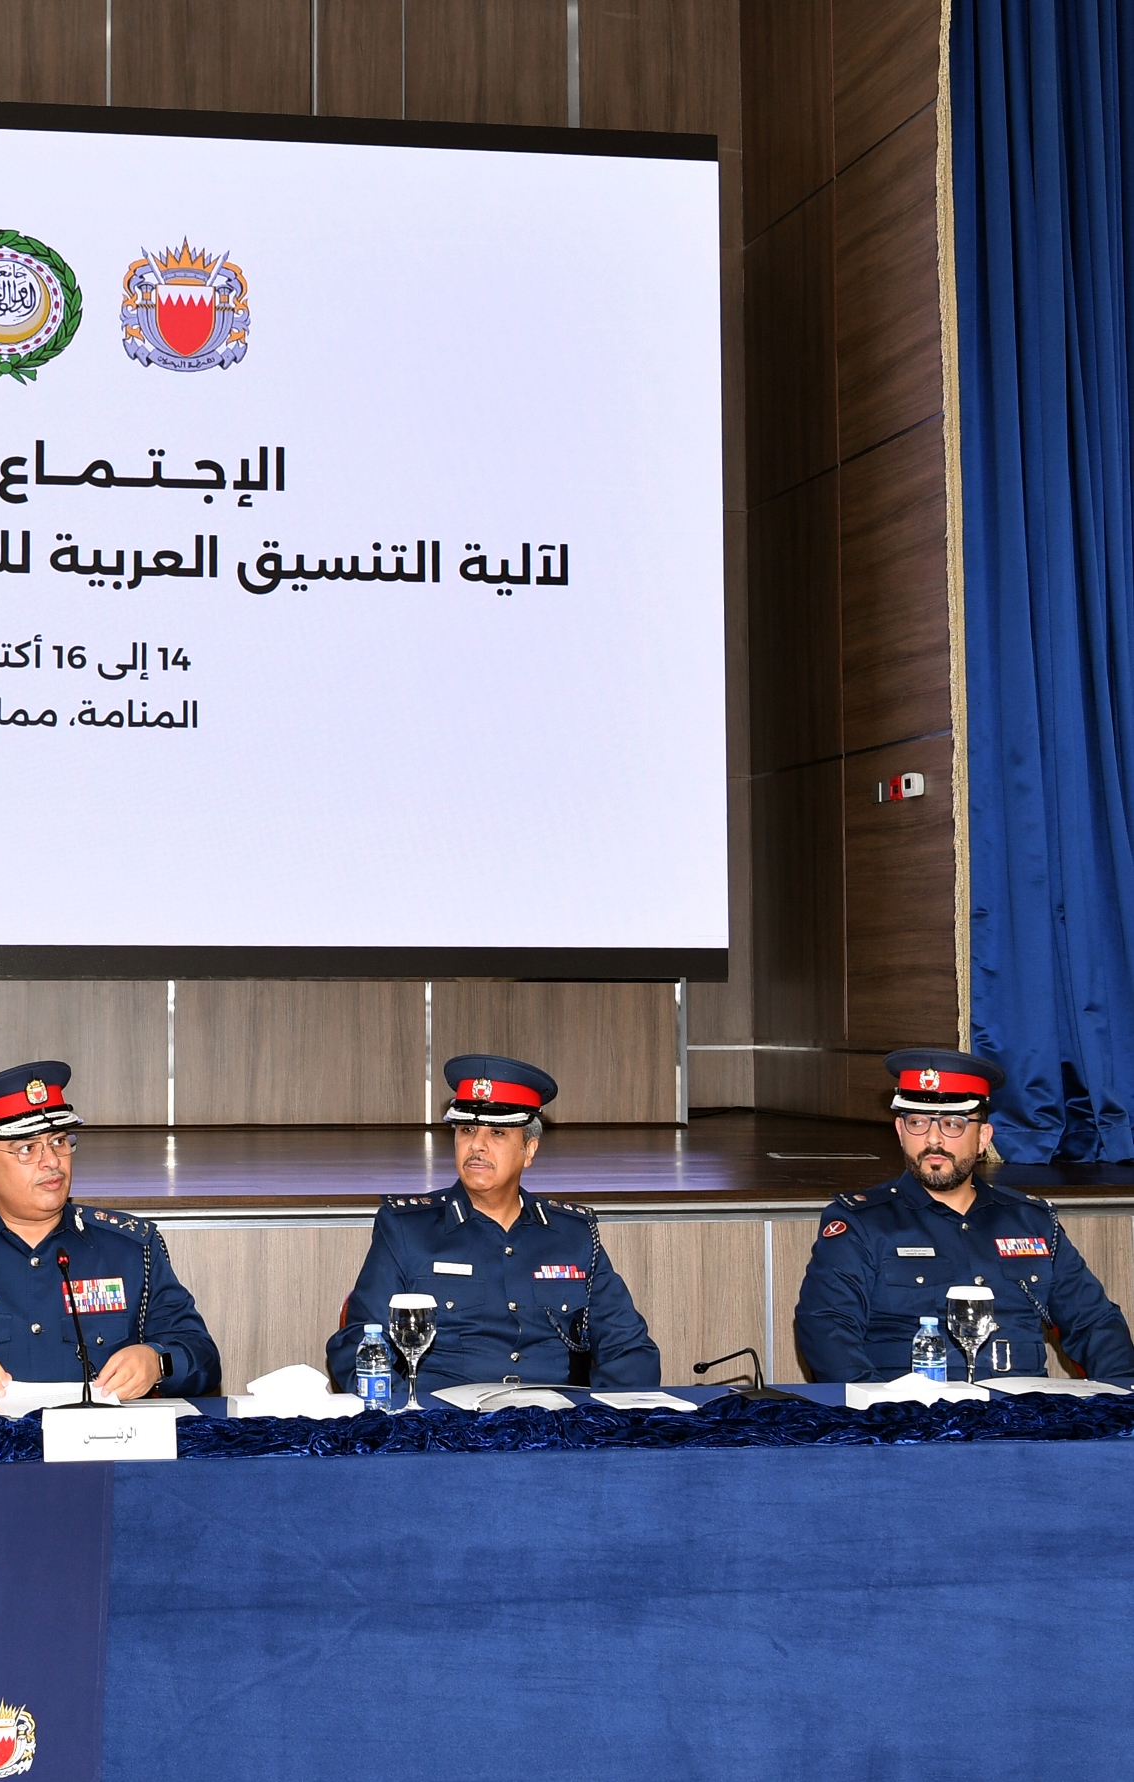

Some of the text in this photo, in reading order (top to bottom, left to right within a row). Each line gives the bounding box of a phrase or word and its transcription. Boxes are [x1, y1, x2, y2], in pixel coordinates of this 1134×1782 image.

[49, 533, 218, 592] العربية
[237, 539, 442, 595] التنسيق
[459, 541, 570, 597] لآلية
[52, 645, 88, 670] 16
[96, 641, 150, 681] إلى
[157, 647, 193, 672] 14
[68, 699, 199, 729] المنامة،
[82, 1426, 138, 1445] الرئيس
